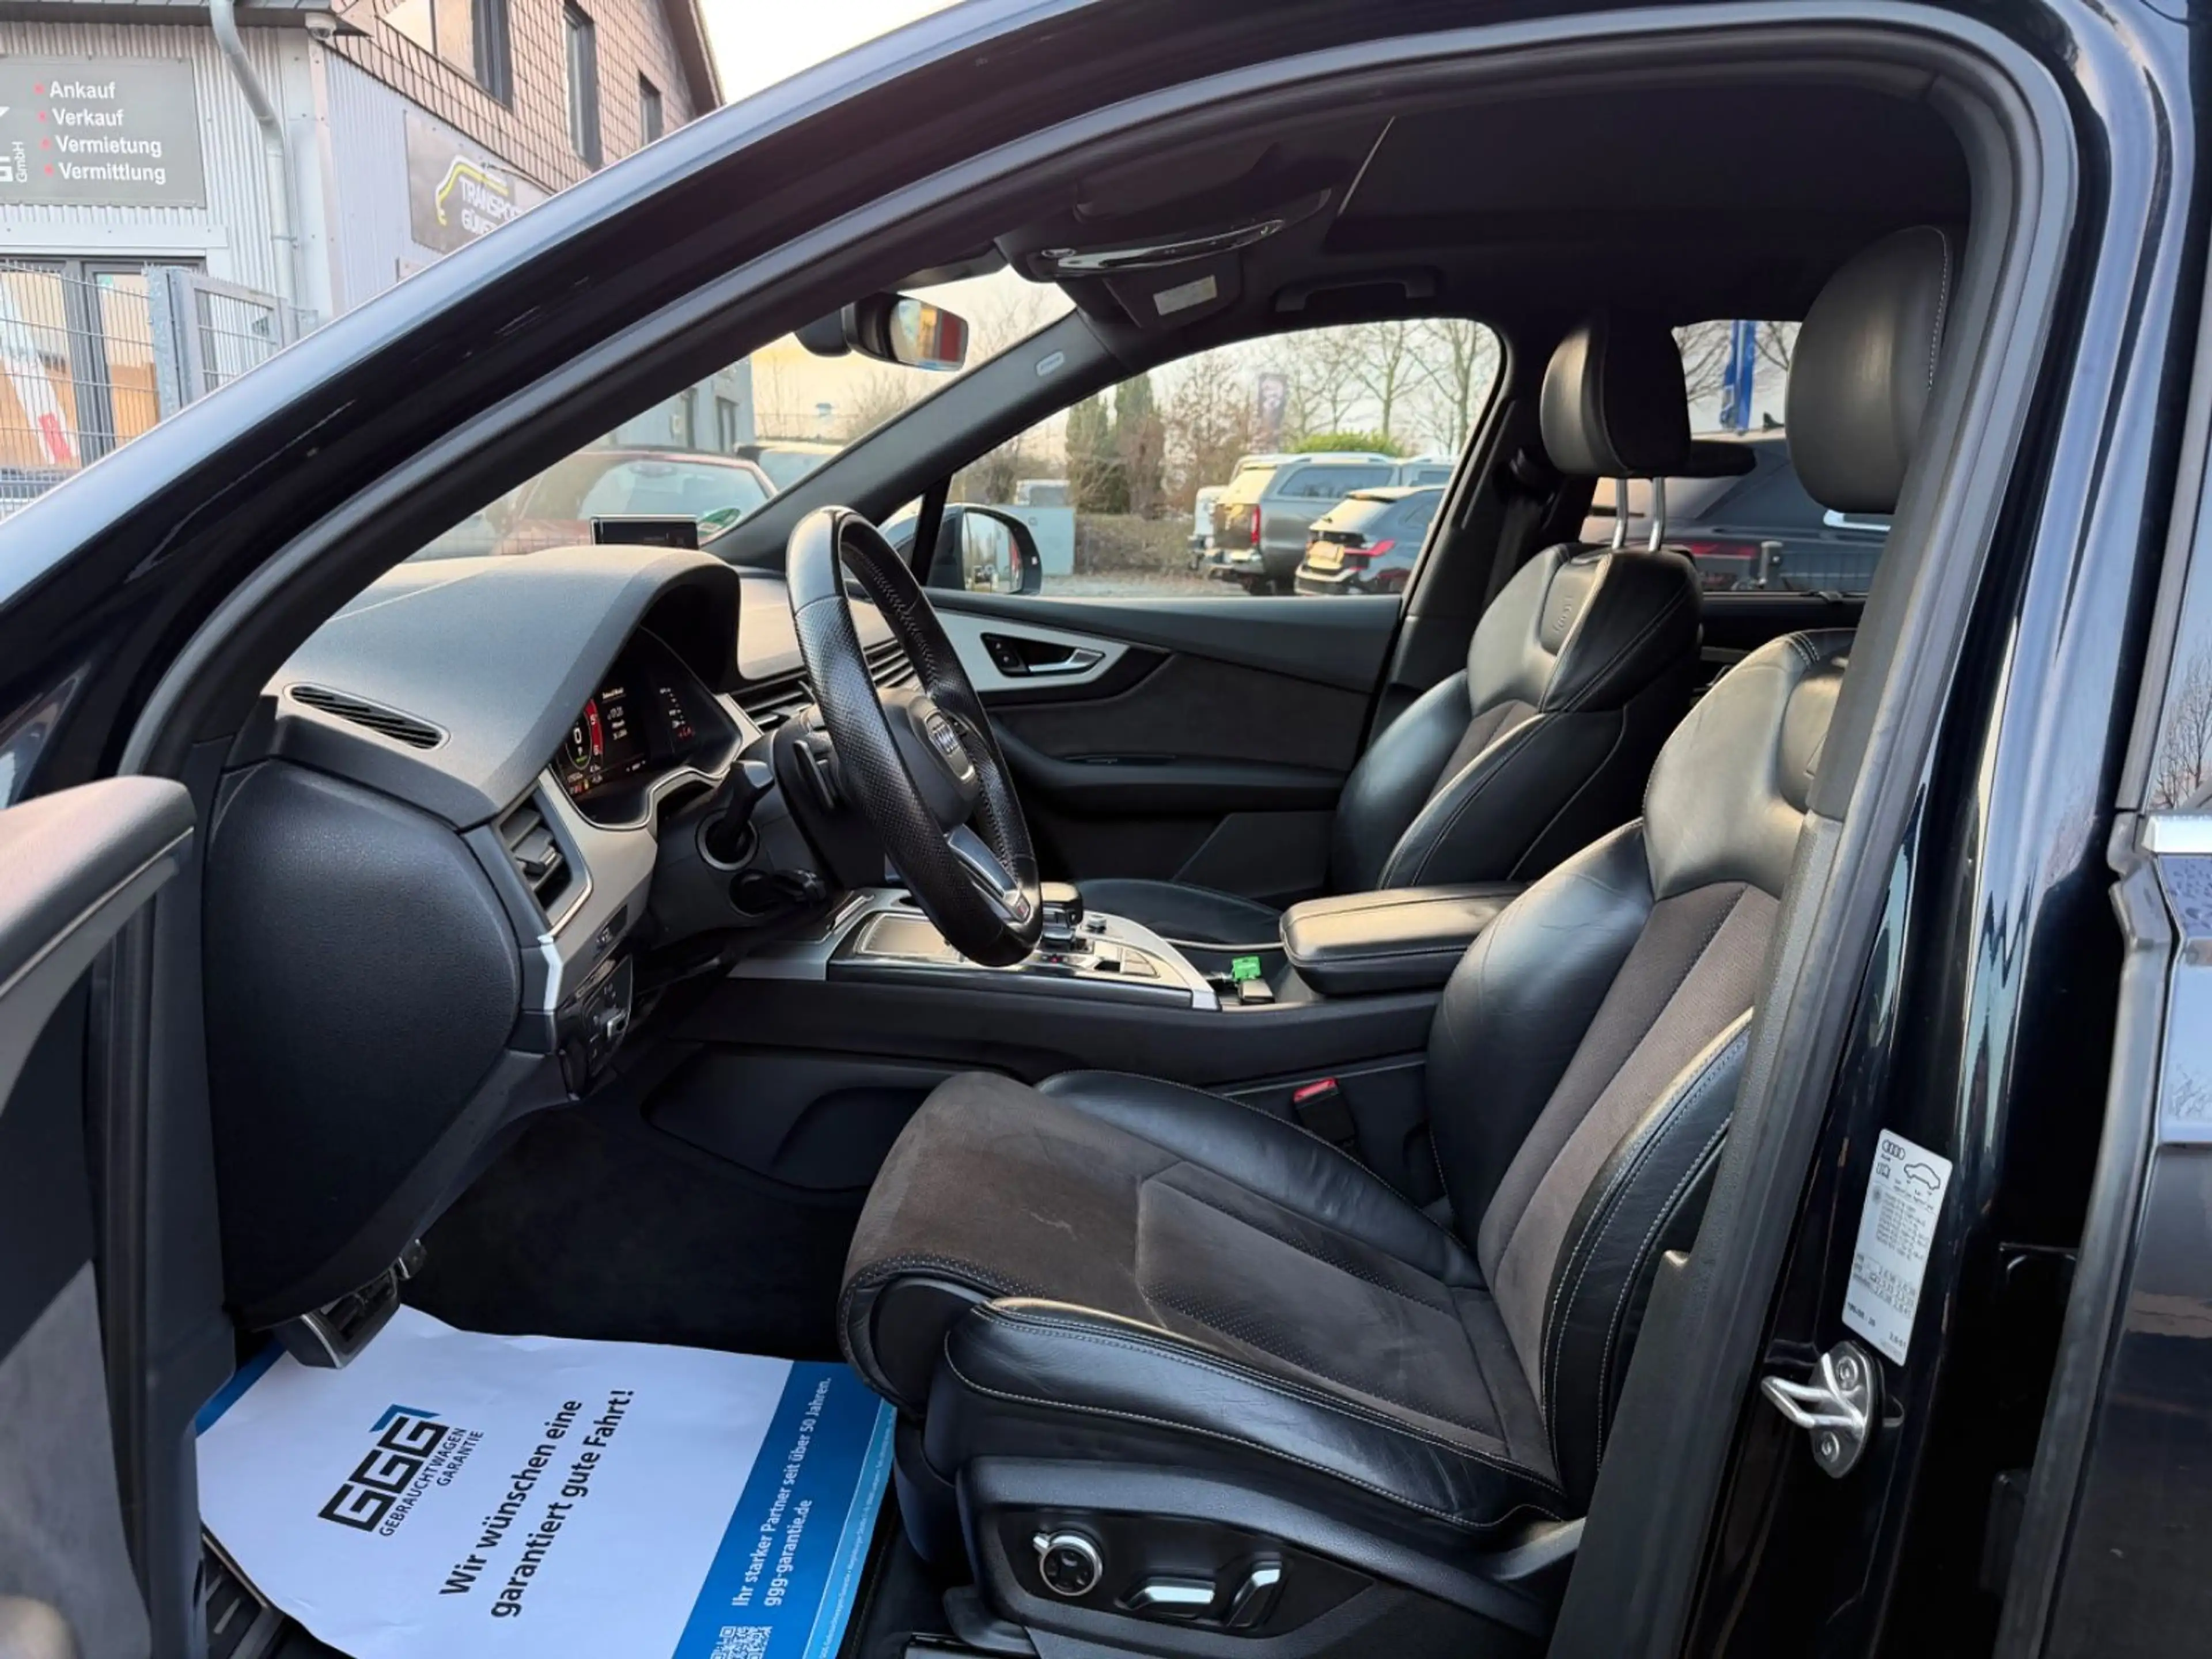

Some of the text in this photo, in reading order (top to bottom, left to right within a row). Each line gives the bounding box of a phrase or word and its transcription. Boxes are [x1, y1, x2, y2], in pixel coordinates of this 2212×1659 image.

[50, 81, 115, 99] Ankauf
[52, 108, 124, 127] Verkauf
[12, 141, 28, 183] GmbH
[55, 135, 162, 158] Vermietung
[58, 162, 166, 185] Vermittlung
[317, 1417, 449, 1532] GGG
[380, 1427, 467, 1537] GEBRAUCHTWAGEN
[437, 1431, 483, 1486] GARANTIE
[438, 1400, 582, 1595] Wir wünschen eine
[731, 1377, 832, 1606] Ihr starker Partner seit über 50 Jahren.
[490, 1389, 634, 1618] garantiert gute Fahrt!
[764, 1499, 813, 1607] ggg-garantie.de
